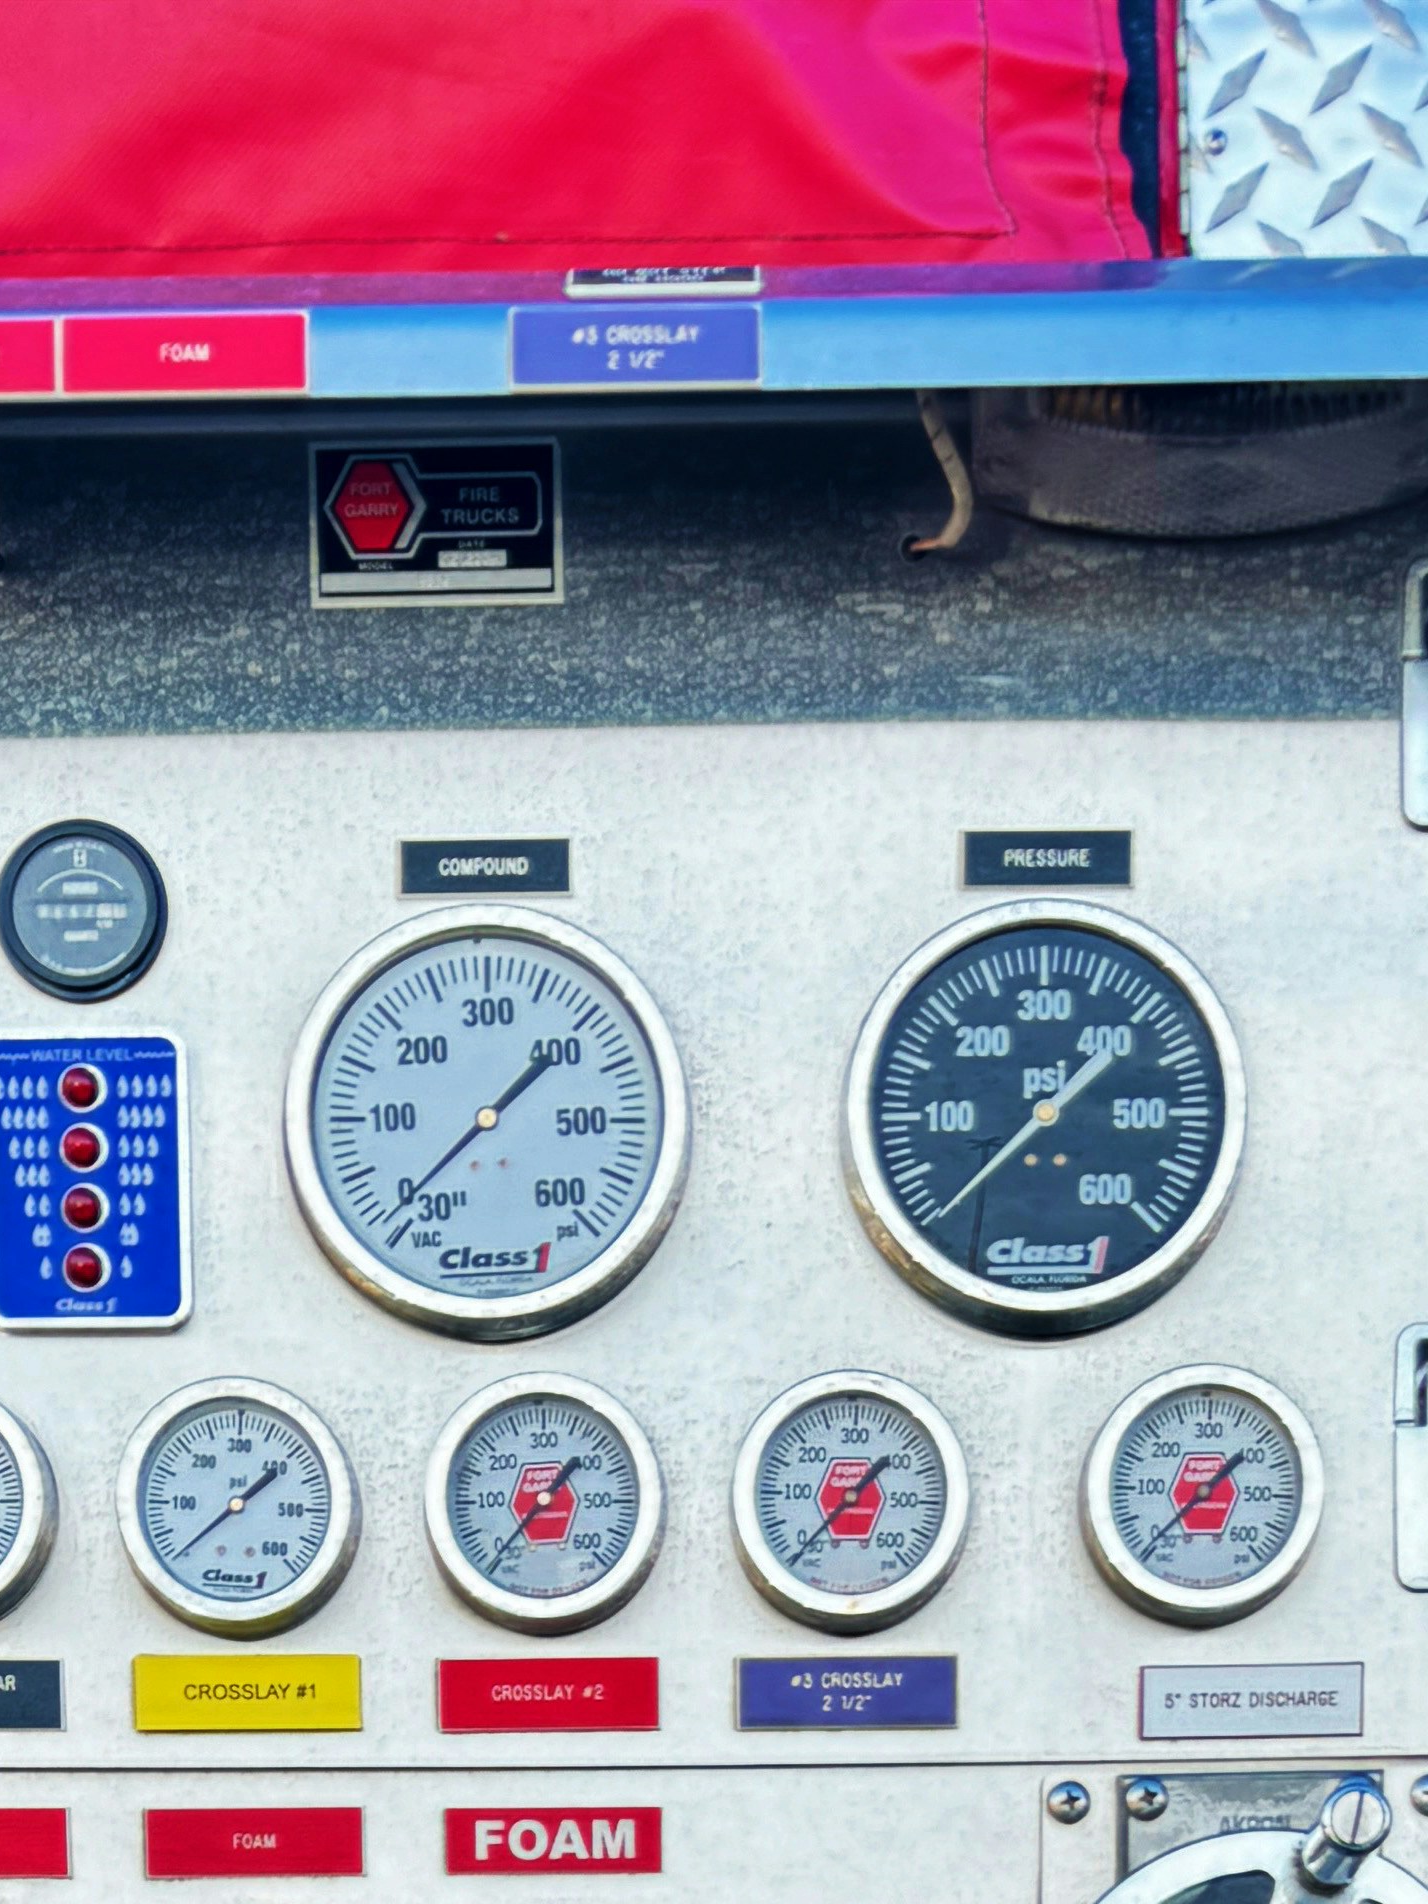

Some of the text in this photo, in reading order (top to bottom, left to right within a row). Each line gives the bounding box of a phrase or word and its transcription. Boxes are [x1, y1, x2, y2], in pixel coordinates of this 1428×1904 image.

[159, 343, 210, 361] FOAM
[439, 857, 529, 875] COMPOUND
[1004, 848, 1091, 867] PRESSURE
[462, 997, 514, 1026] 300
[1017, 989, 1072, 1019] 300
[397, 1036, 448, 1064] 200
[956, 1025, 1010, 1055] 200
[29, 1050, 134, 1061] WATER LEVEL
[1023, 1060, 1068, 1098] psi
[370, 1103, 416, 1131] 100
[556, 1106, 607, 1135] 500
[925, 1101, 974, 1131] 100
[1113, 1098, 1165, 1128] 500
[535, 1178, 585, 1206] 600
[1080, 1173, 1132, 1203] 600
[183, 1683, 316, 1699] CROSSLAY #1
[491, 1684, 604, 1700] CROSSLAY #2
[1164, 1691, 1339, 1708] 5" STORZ DISCHARGE
[233, 1833, 277, 1849] FOAM
[474, 1819, 636, 1860] FOAM
